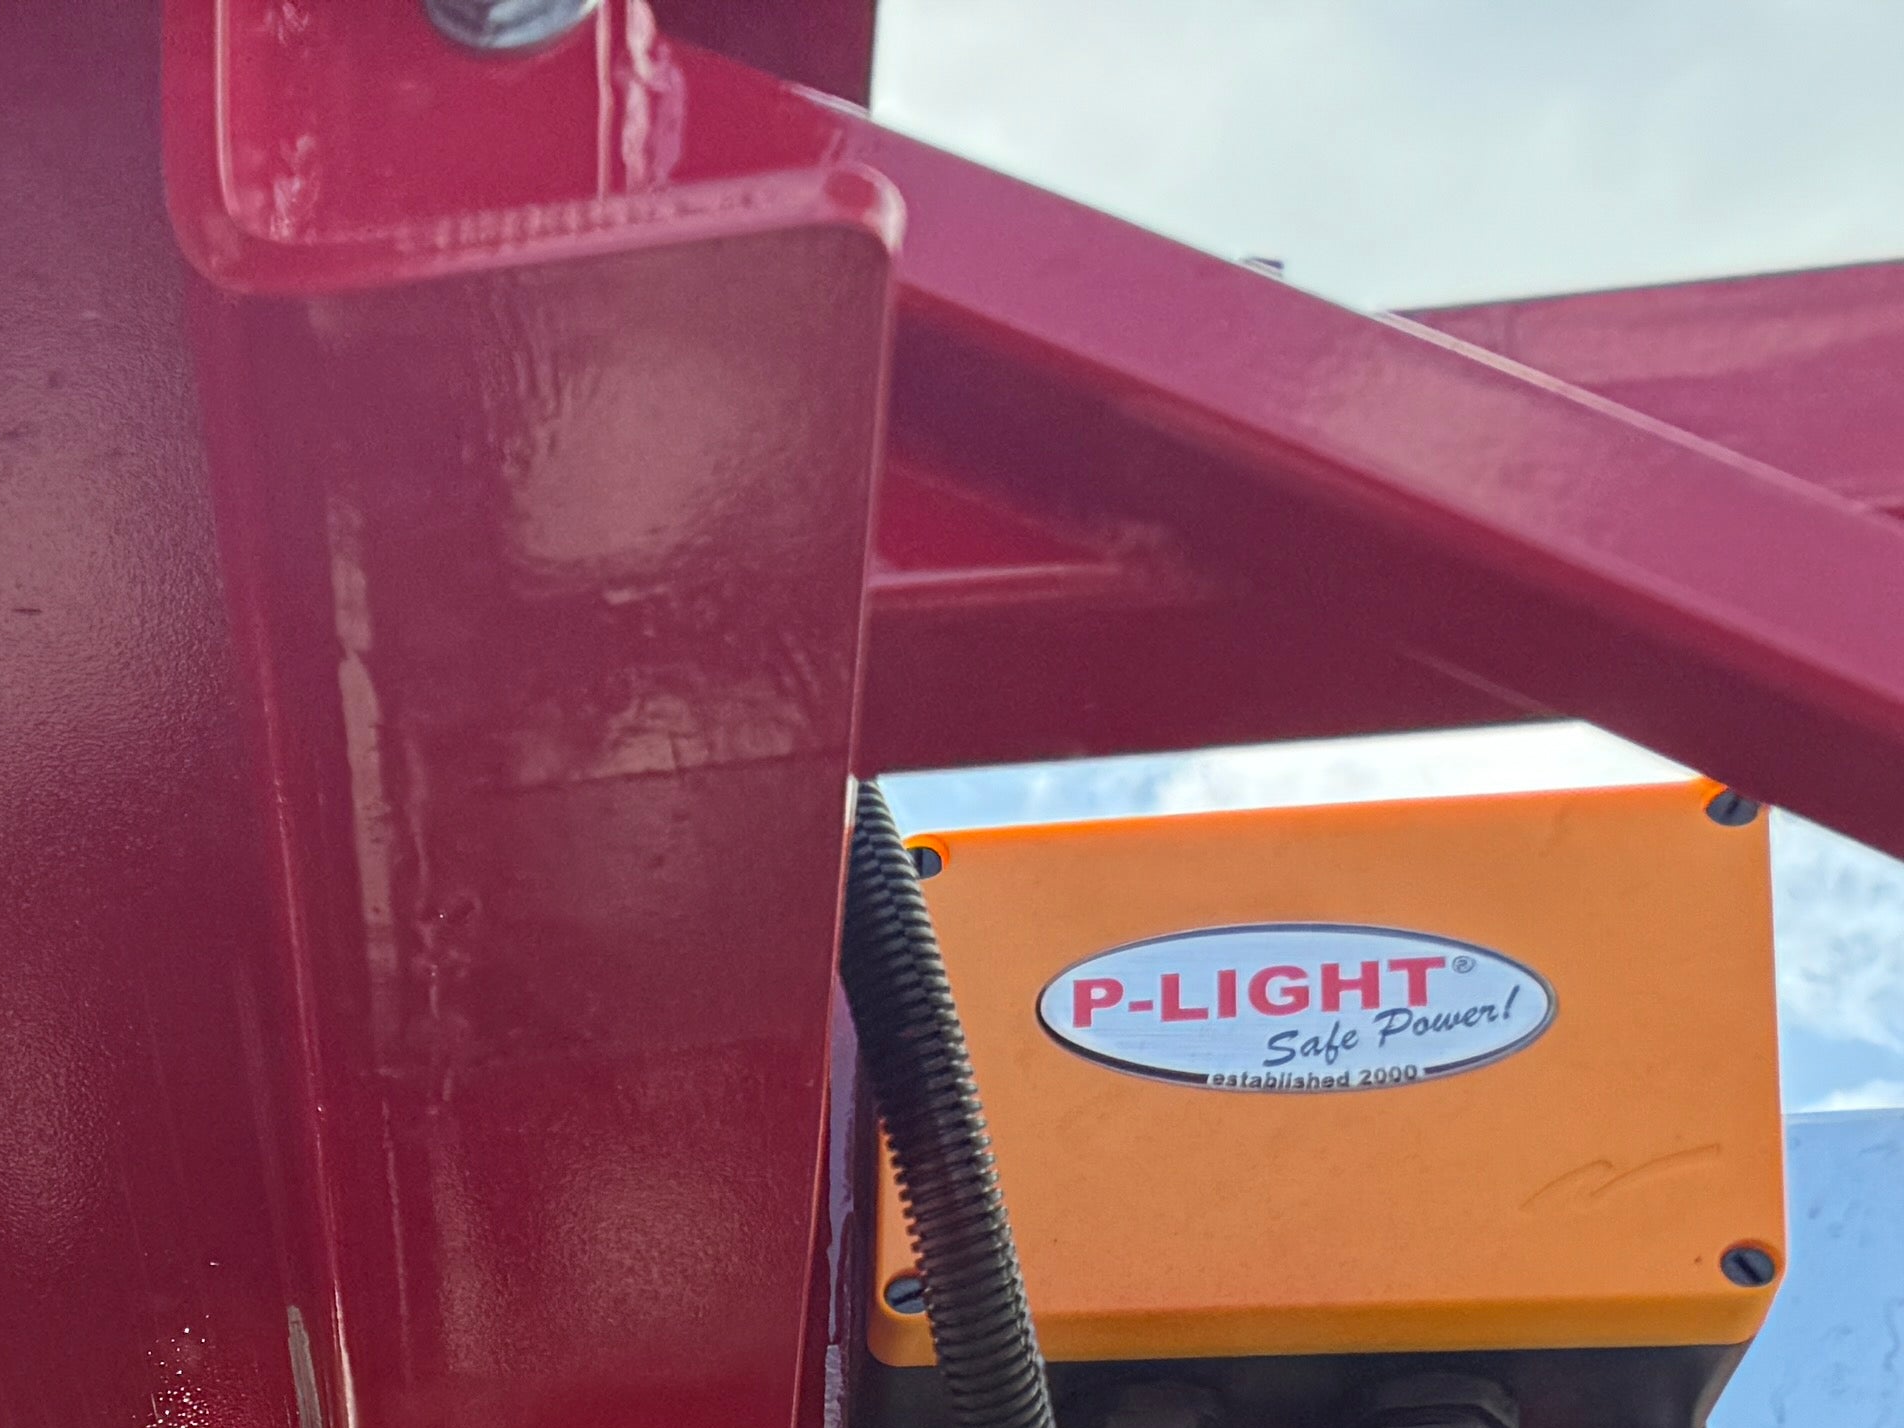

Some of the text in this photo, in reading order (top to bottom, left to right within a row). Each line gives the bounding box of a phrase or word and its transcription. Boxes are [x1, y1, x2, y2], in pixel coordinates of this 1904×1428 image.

[1072, 956, 1447, 1028] P-LIGHT
[1262, 984, 1521, 1067] Safe Power!
[1211, 1064, 1418, 1090] established 2000
